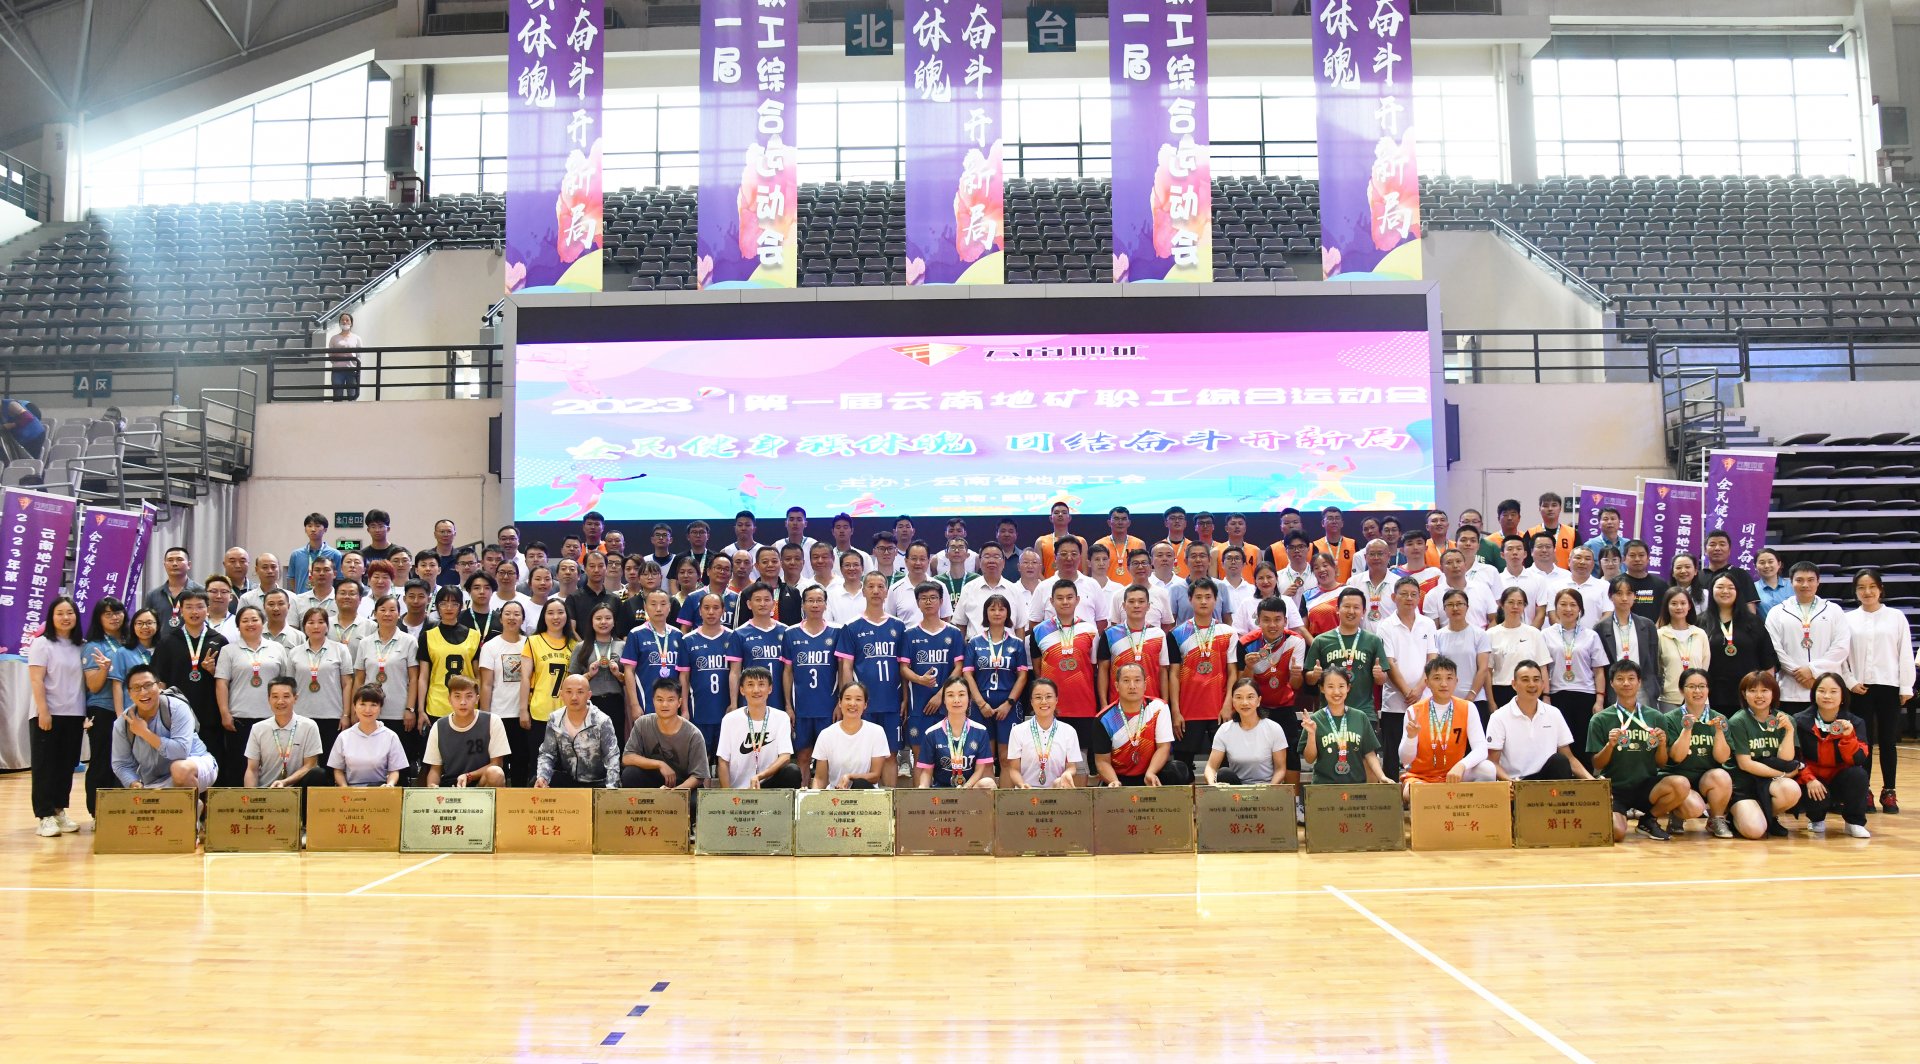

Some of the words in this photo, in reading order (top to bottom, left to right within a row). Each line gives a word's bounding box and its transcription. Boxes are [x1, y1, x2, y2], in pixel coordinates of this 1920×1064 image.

[851, 14, 887, 49] 北
[1035, 10, 1068, 46] 台
[517, 0, 557, 107] 体魄
[713, 17, 742, 83] 一届
[1122, 13, 1151, 81] 一届
[756, 0, 787, 267] 工综合运动会
[1165, 0, 1200, 266] 工综合运动会
[552, 397, 694, 416] 2023
[875, 641, 896, 655] HOT
[808, 650, 830, 664] HOT
[928, 649, 949, 663] HOT
[809, 668, 818, 688] 3
[876, 660, 890, 682] 11
[549, 663, 567, 698] 7
[710, 673, 719, 694] 8
[989, 672, 998, 690] 9
[1453, 728, 1462, 744] 7
[466, 738, 484, 755] 28
[128, 824, 163, 836] 第二名
[230, 823, 276, 835] 第十一名
[337, 823, 371, 835] 第九名
[430, 824, 465, 836] 第四名
[527, 824, 561, 836] 第七名
[624, 825, 659, 837] 第八名
[727, 825, 762, 837] 第三名
[1229, 823, 1265, 834] 第六名
[1444, 820, 1480, 831] 第一名
[1547, 818, 1582, 830] 第十名
[827, 826, 862, 838] 第五名
[927, 826, 963, 838] 第四名
